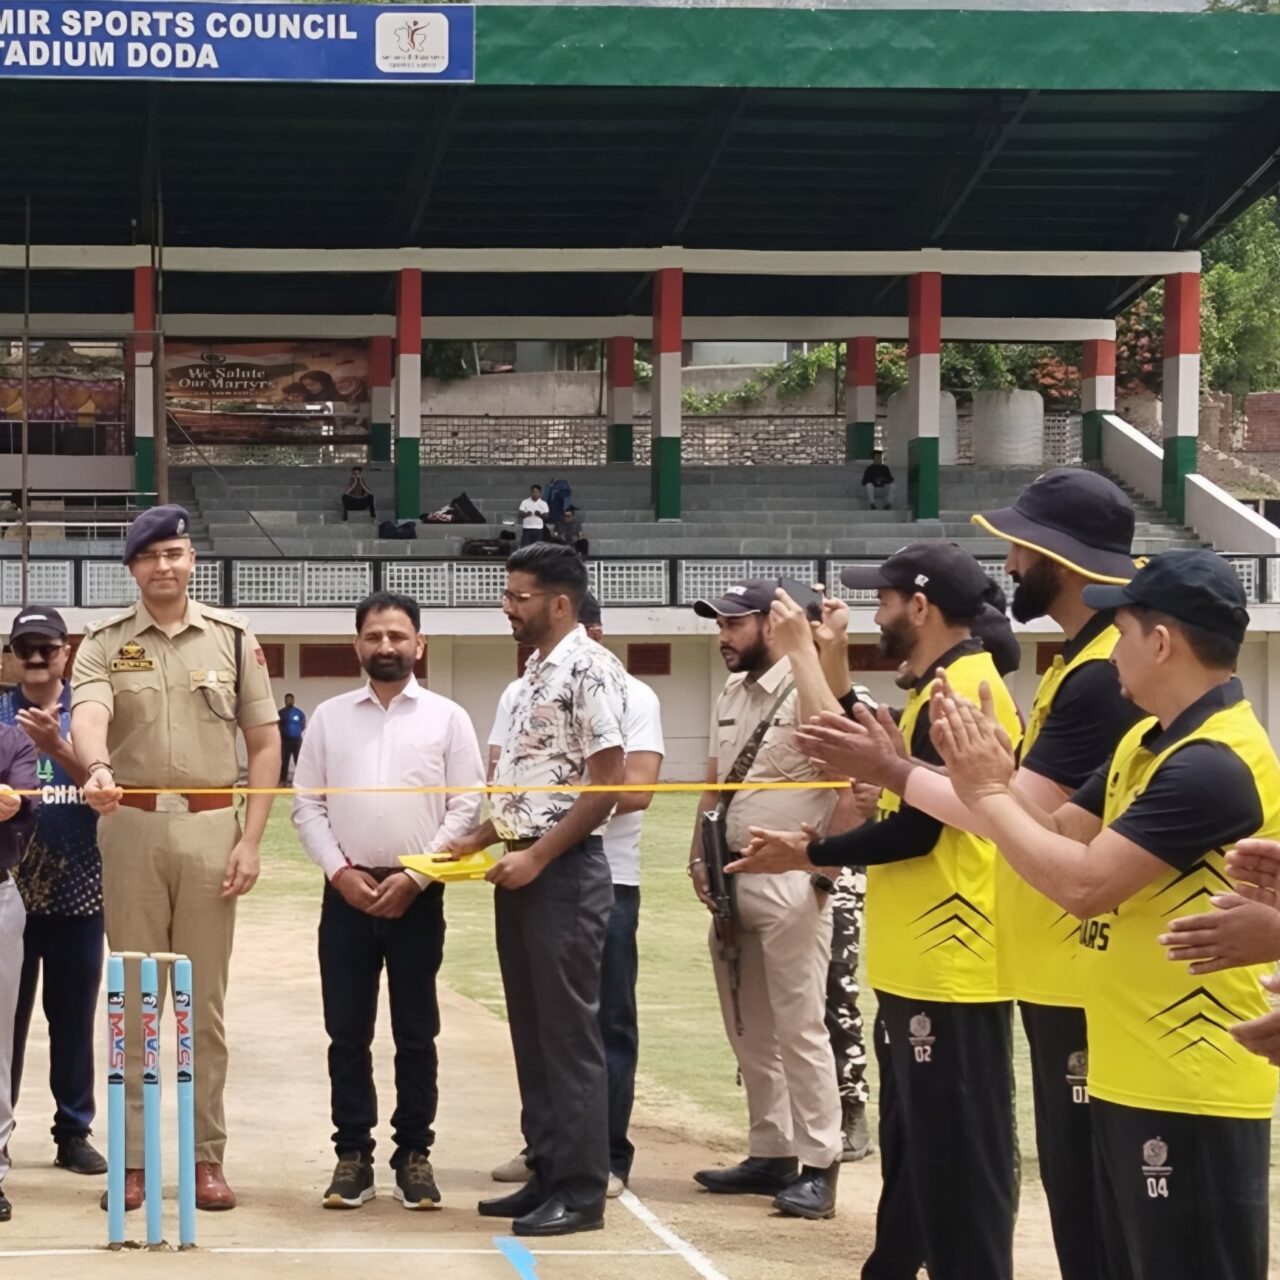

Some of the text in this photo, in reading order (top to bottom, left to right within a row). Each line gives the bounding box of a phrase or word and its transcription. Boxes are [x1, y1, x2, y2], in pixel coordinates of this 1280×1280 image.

[61, 10, 195, 38] SPORTS
[206, 13, 358, 39] COUNCIL
[127, 42, 219, 69] DODA
[179, 378, 206, 388] Our
[914, 1045, 932, 1063] 02
[1146, 1177, 1169, 1198] 04
